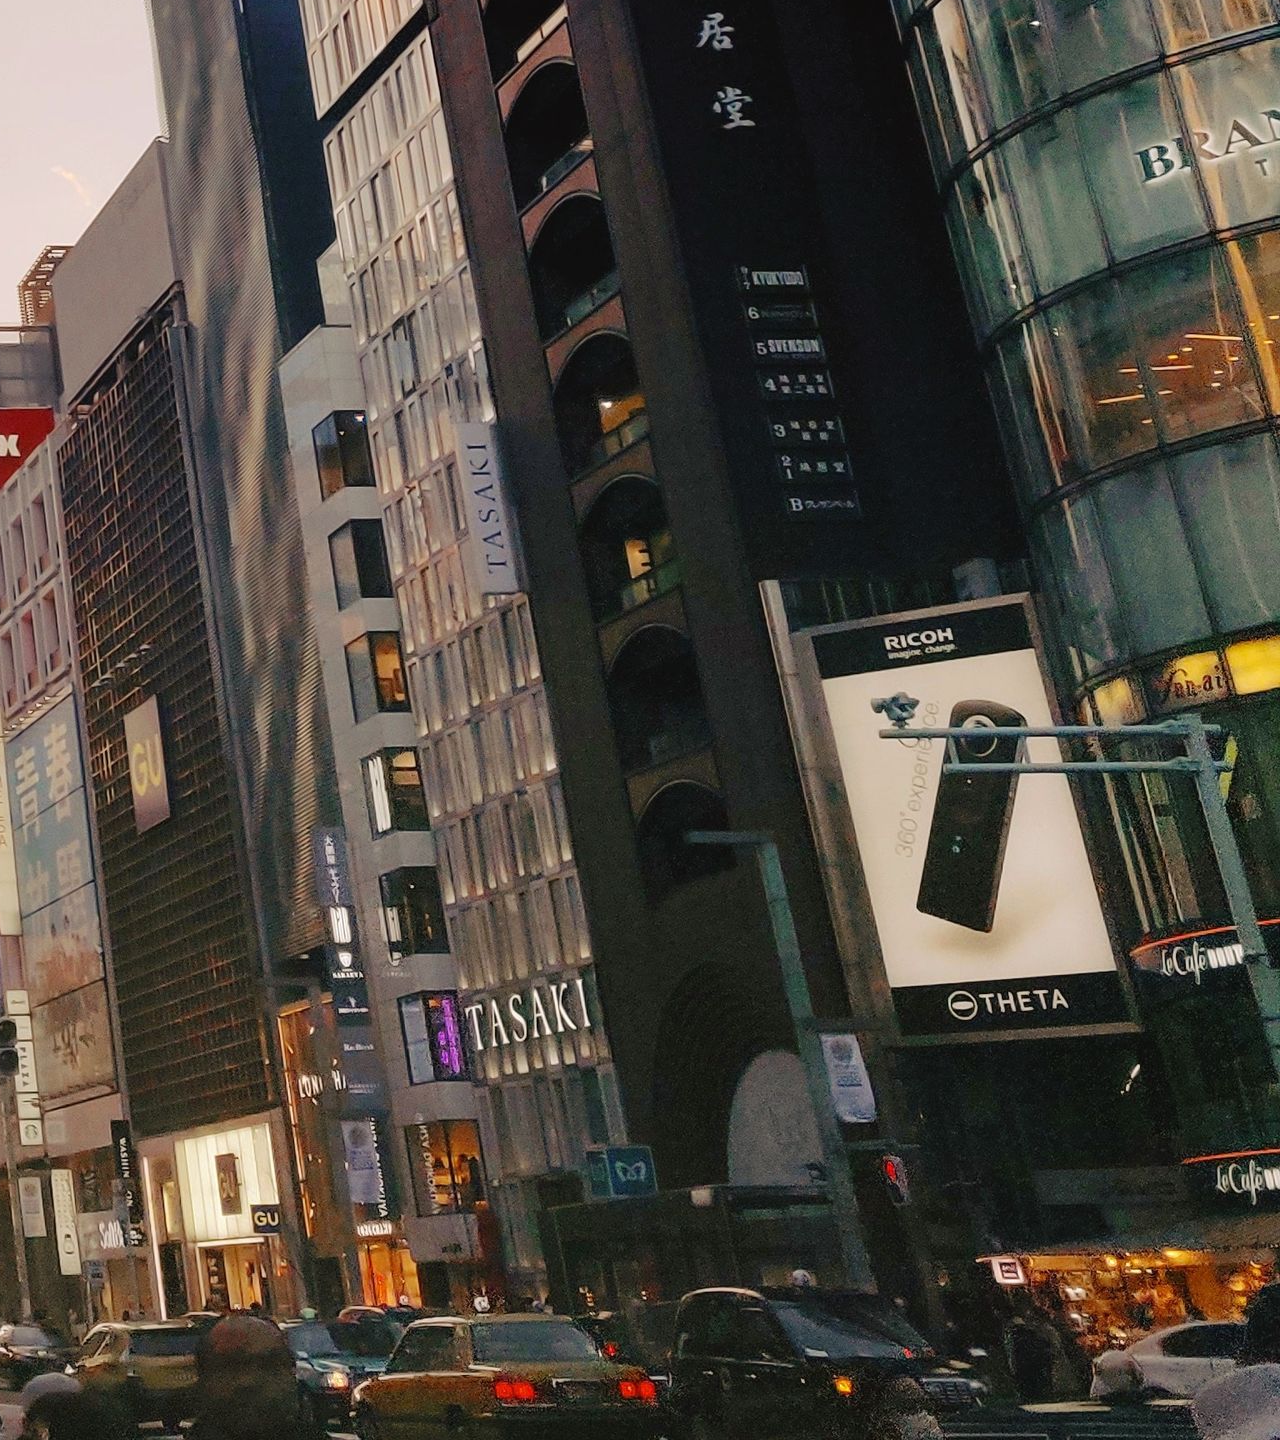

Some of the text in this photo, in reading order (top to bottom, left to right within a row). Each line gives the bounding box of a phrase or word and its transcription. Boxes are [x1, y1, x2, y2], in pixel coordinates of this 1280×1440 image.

[466, 444, 507, 574] TASAKI
[790, 498, 803, 511] B
[884, 627, 954, 651] RICOH
[925, 642, 958, 655] change.
[132, 733, 162, 797] GU
[979, 989, 1068, 1014] THETA
[464, 979, 591, 1051] TASAKI
[254, 1211, 279, 1227] GU
